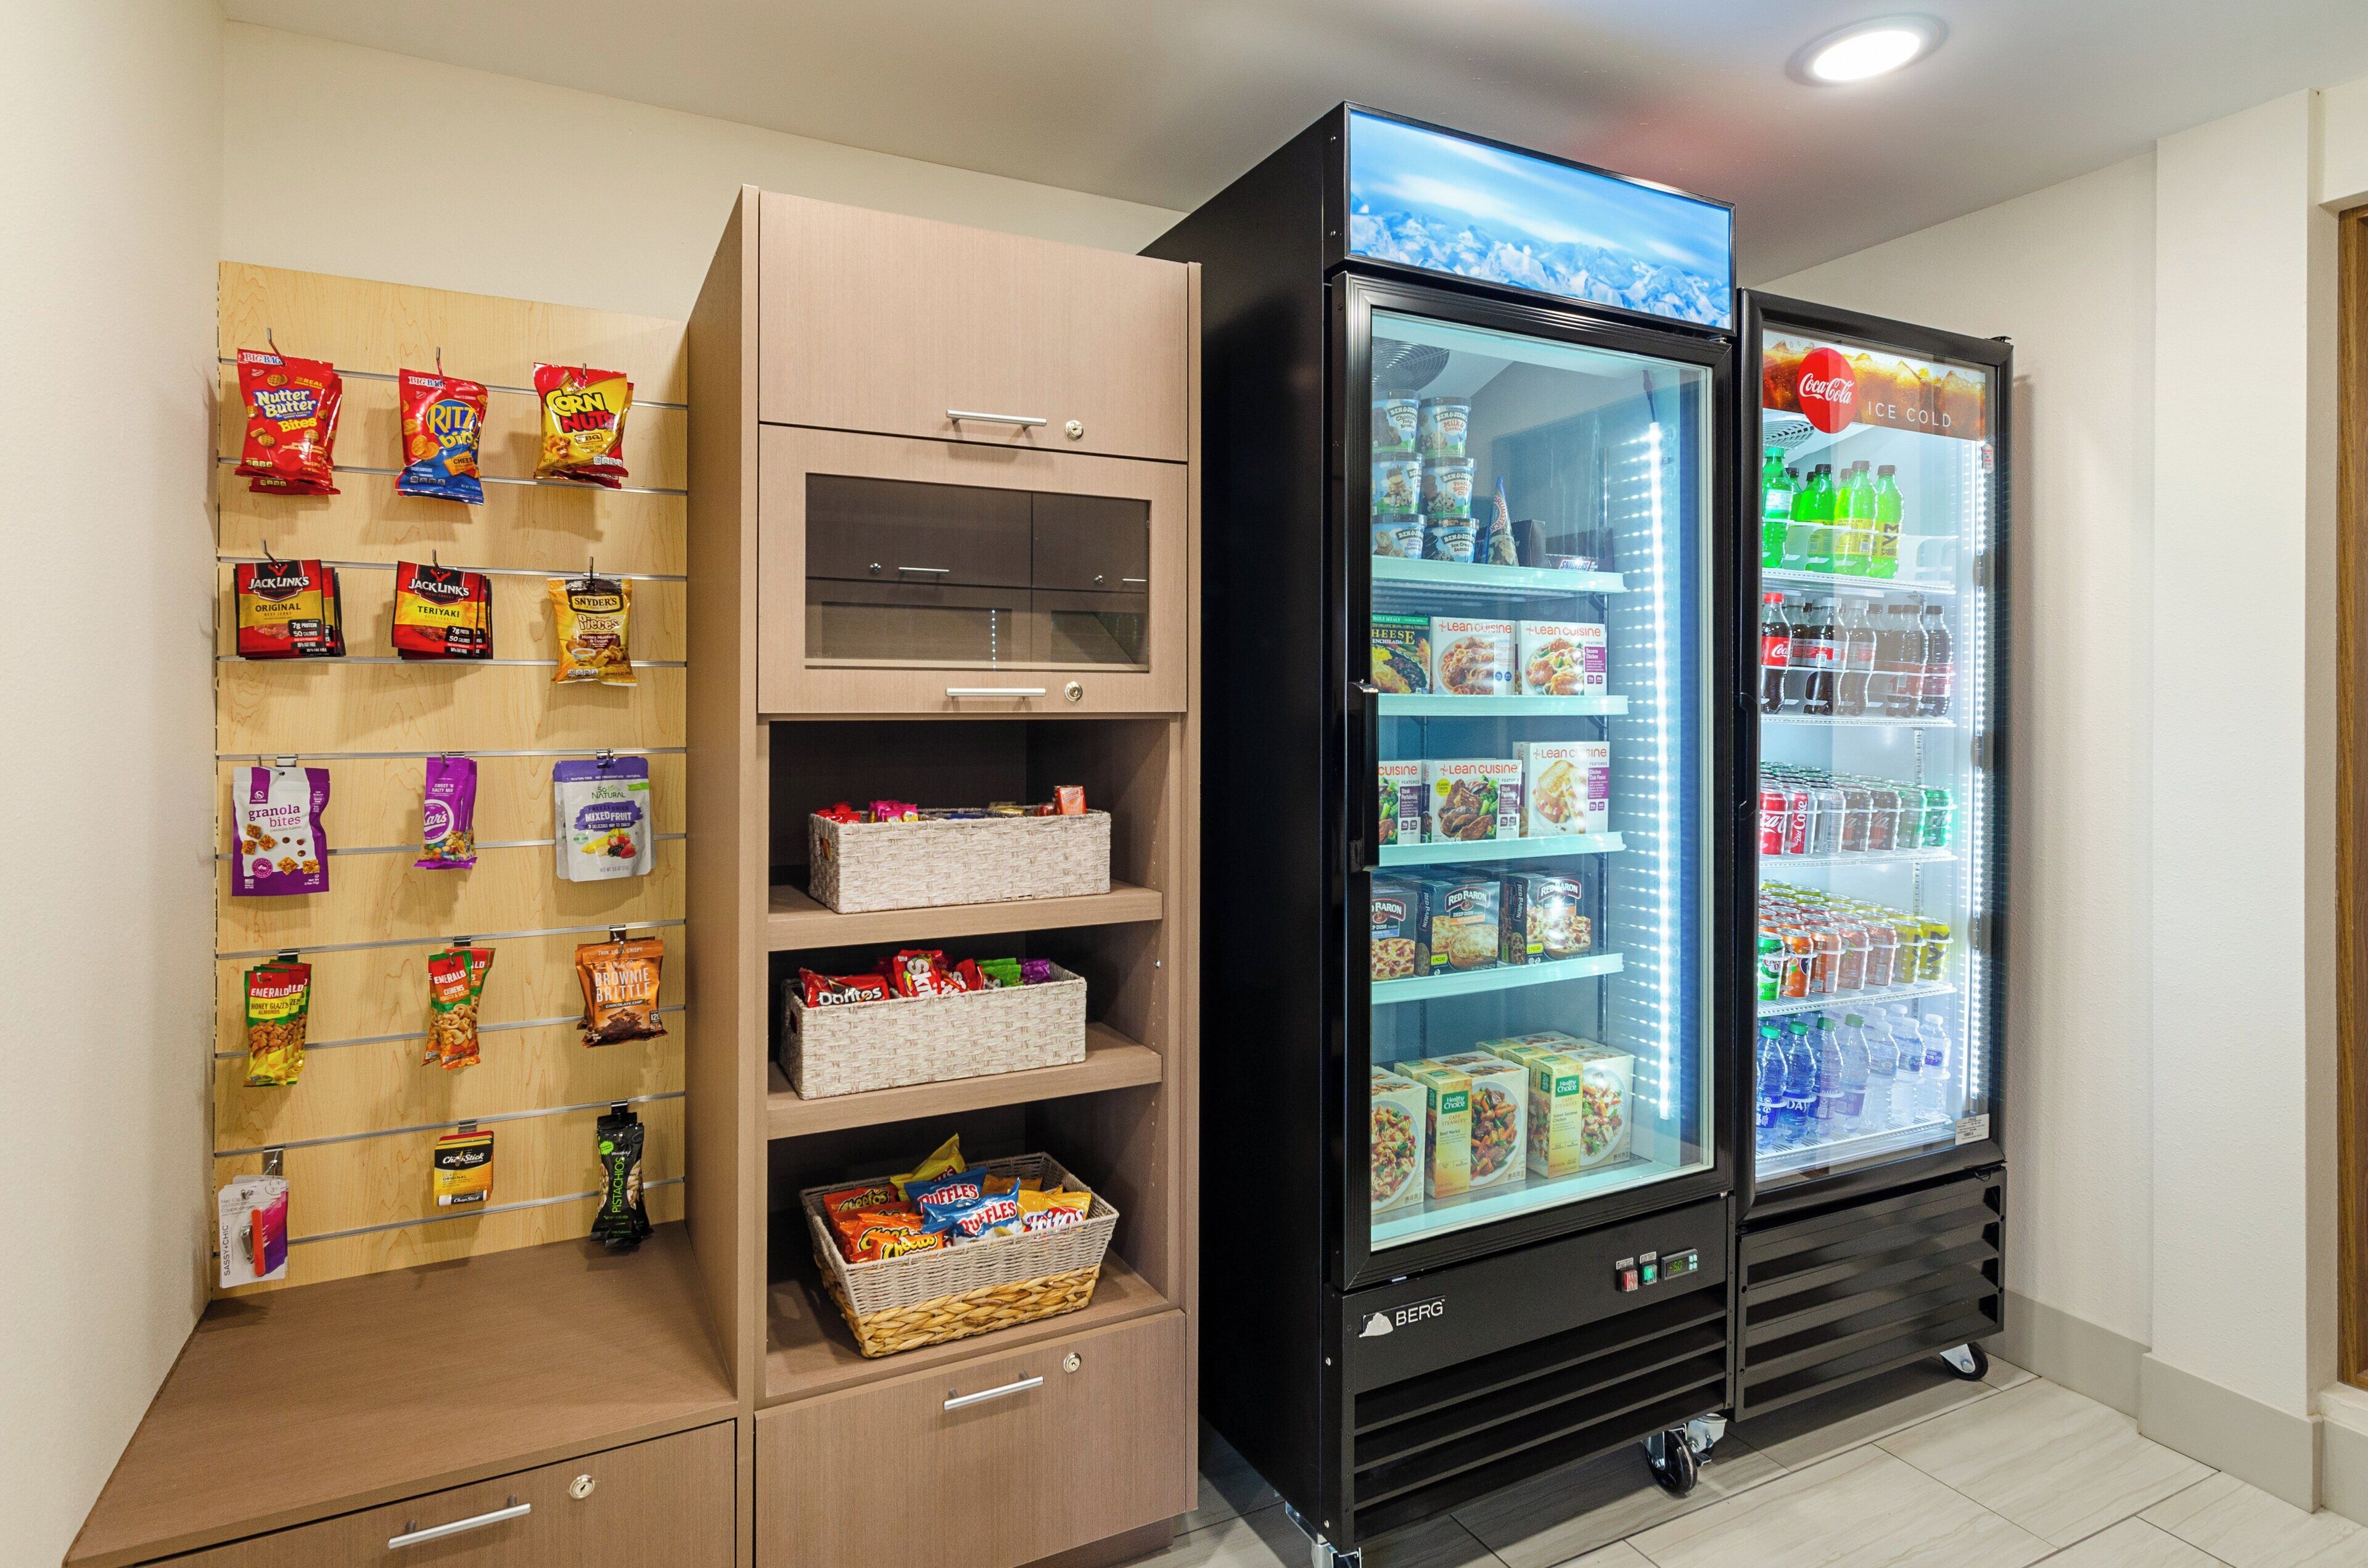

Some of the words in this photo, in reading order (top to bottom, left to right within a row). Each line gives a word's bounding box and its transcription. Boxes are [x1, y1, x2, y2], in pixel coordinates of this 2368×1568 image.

[244, 352, 263, 363] BIG
[263, 356, 282, 365] BAG
[303, 378, 323, 387] REAL
[408, 376, 426, 385] BIG
[427, 379, 443, 388] BAG
[1799, 372, 1855, 404] Coca-Cola
[255, 390, 310, 406] Nutter
[546, 389, 606, 416] CORN
[264, 400, 316, 417] Butter
[1868, 401, 1896, 419] ICE
[1906, 408, 1952, 427] COLD
[278, 417, 317, 432] Bites
[429, 404, 475, 433] RITZ
[248, 577, 276, 589] JACK
[277, 576, 310, 588] LINK'S
[409, 578, 437, 593] JACK
[438, 583, 469, 596] LINK'S
[255, 603, 301, 612] ORIGINAL
[574, 597, 617, 607] SNYDER'S
[417, 605, 460, 618] TERIYAKI
[577, 614, 619, 630] Pieces
[1371, 629, 1415, 645] HEESE
[249, 805, 300, 821] granola
[585, 811, 610, 822] MIXED
[610, 812, 632, 821] FRUIT
[269, 816, 301, 827] bites
[1449, 893, 1463, 905] RED
[1463, 890, 1487, 901] BARON
[1375, 902, 1402, 915] BARON
[434, 969, 466, 985] EMERALD
[595, 967, 650, 987] BROWNIE
[250, 987, 289, 998] EMERALD
[443, 984, 464, 996] CASHEWS
[596, 982, 651, 1003] BRITTLE
[818, 987, 882, 1006] Doritos
[1557, 1085, 1577, 1093] Choice
[1560, 1079, 1576, 1087] Healthy
[1444, 1101, 1465, 1110] Choice
[1447, 1095, 1465, 1104] Healthy
[612, 1156, 625, 1213] PISTACHIOS
[957, 1200, 1018, 1236] RUFFLES
[1022, 1209, 1085, 1233] Fritos
[881, 1233, 938, 1260] Cheetos
[1396, 1301, 1443, 1326] BERG
